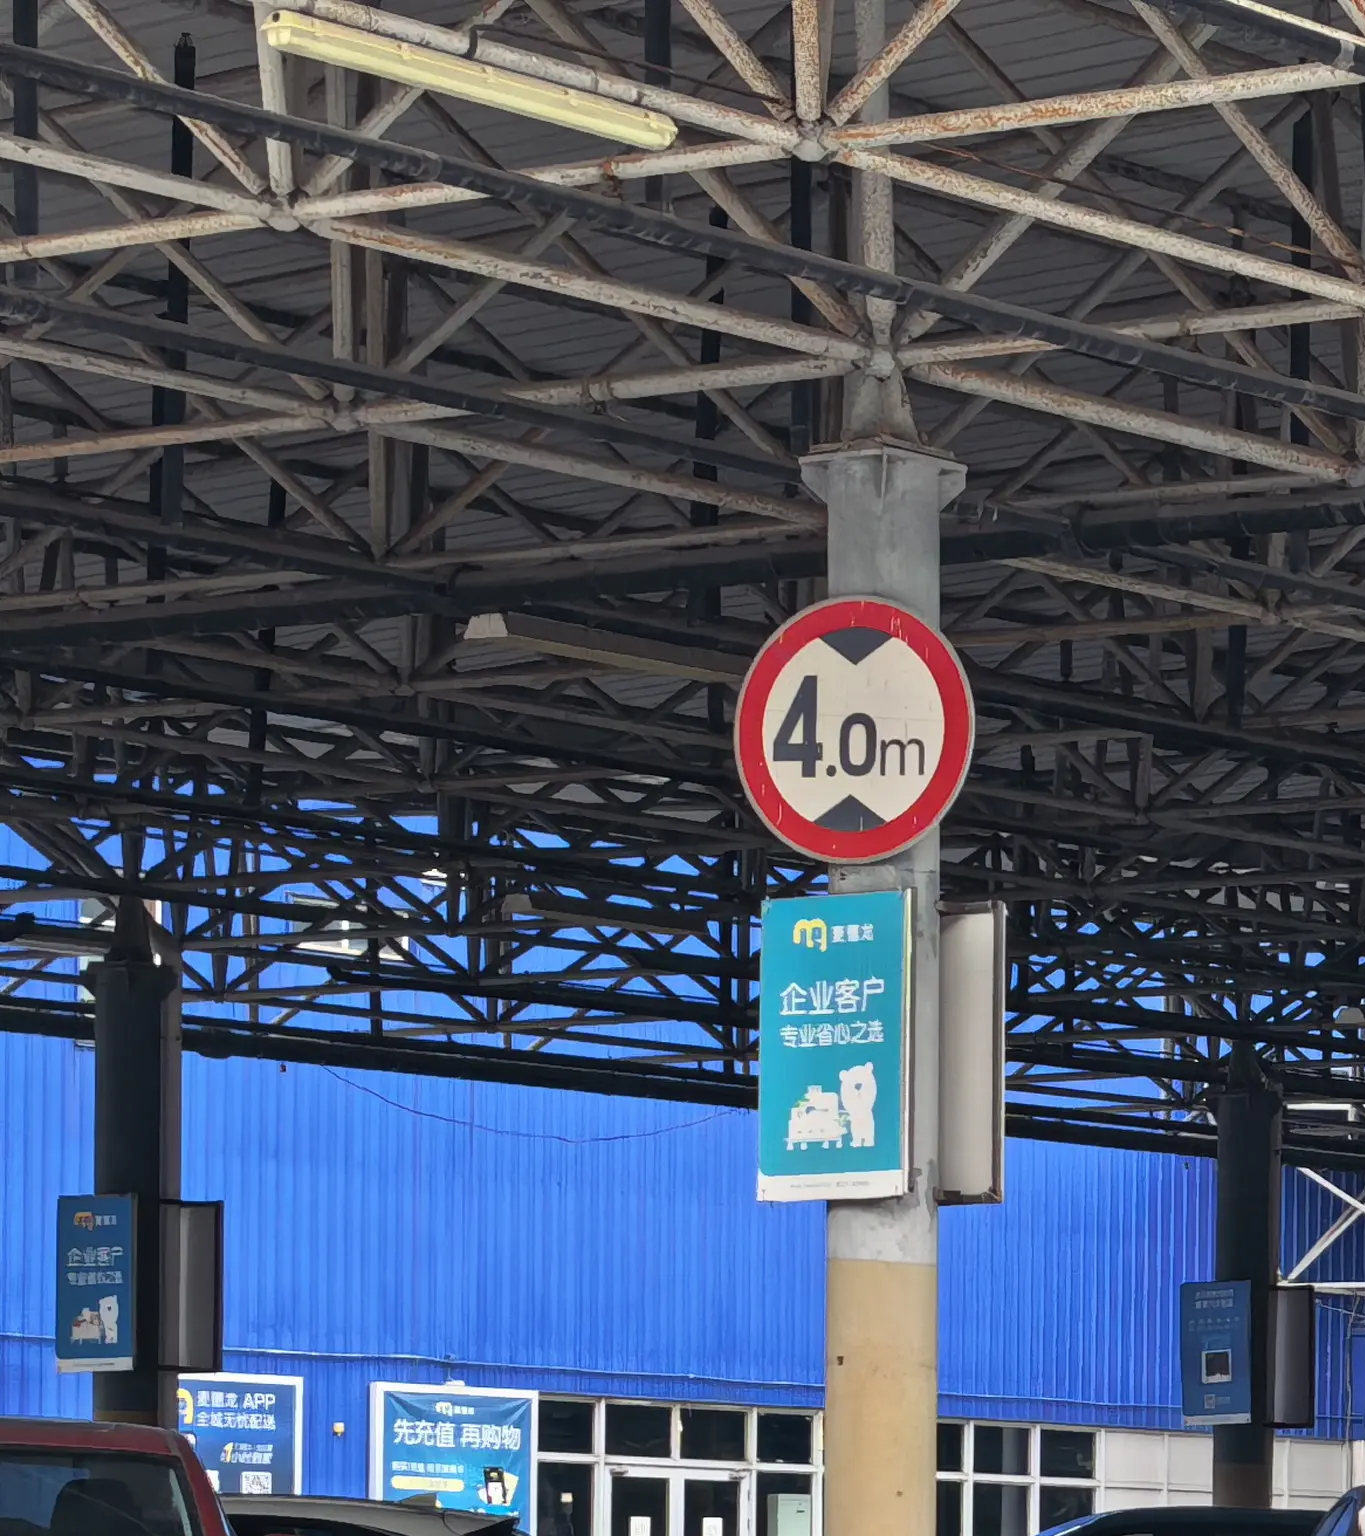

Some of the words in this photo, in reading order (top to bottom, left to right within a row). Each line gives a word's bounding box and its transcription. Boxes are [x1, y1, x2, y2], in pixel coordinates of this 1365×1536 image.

[773, 675, 925, 778] 4.0m
[780, 976, 884, 1015] 企业客户
[780, 1019, 884, 1047] 专业省心之选
[243, 1392, 276, 1410] APP
[393, 1418, 456, 1448] 先充值
[460, 1423, 521, 1450] 再购物
